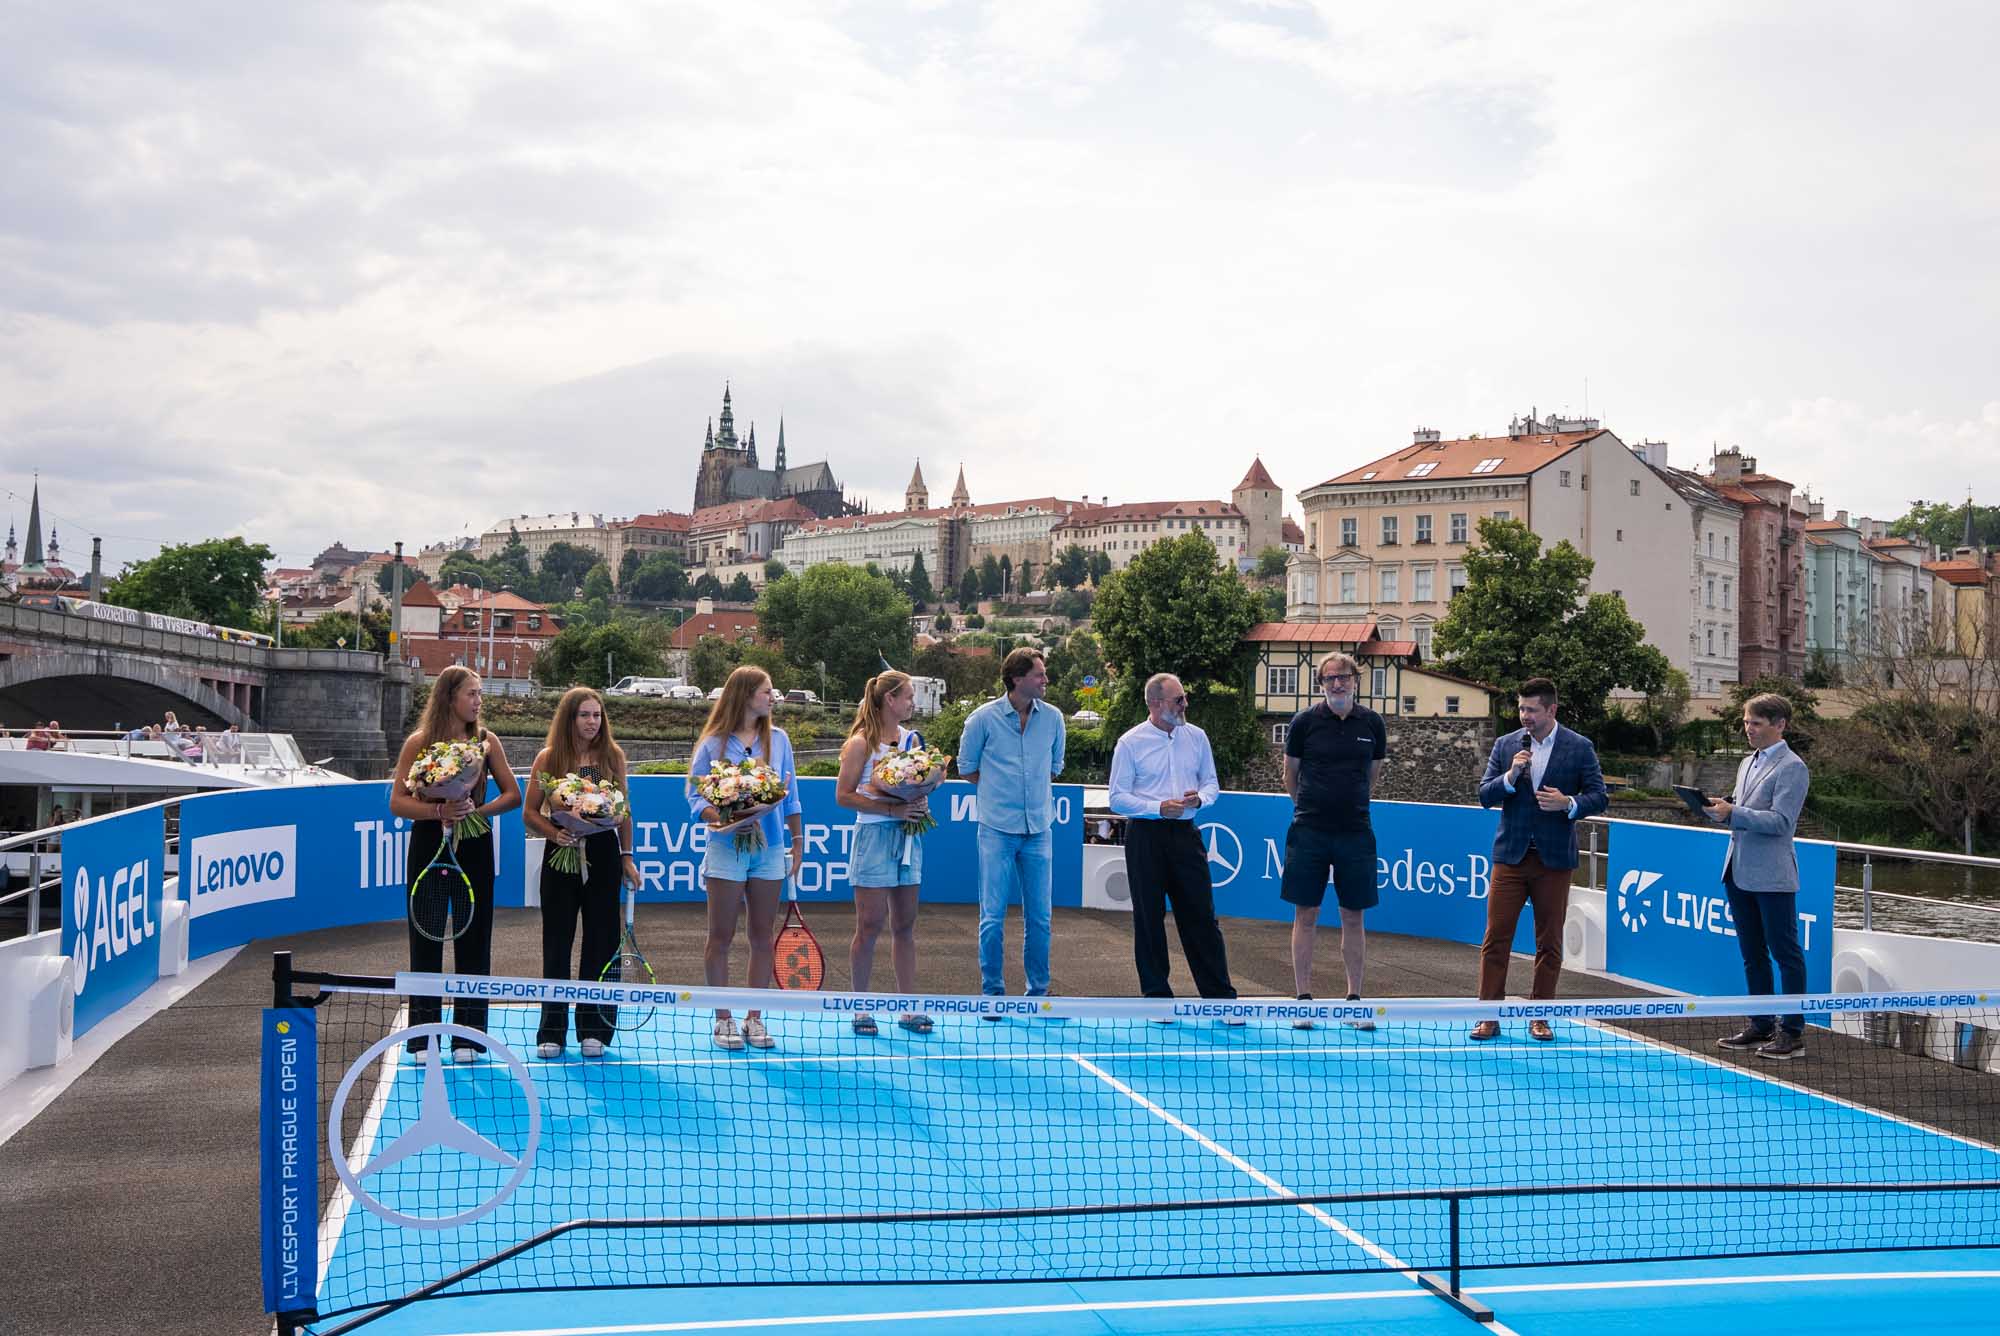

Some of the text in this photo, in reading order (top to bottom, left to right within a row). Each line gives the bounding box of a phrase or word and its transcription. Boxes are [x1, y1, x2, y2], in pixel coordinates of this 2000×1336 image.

[197, 849, 285, 896] Lenovo
[90, 859, 154, 971] AGEL
[1663, 890, 1817, 951] LIVEST
[445, 980, 676, 1004] LIVESPORT PRAGUE OPEN
[1801, 994, 1976, 1011] LIVESPORT PRAGUE OPEN
[823, 998, 1038, 1014] LIVESPORT PRAGUE OPEN
[1174, 1004, 1373, 1019] LIVESPORT PRAGUE OPEN
[1498, 1003, 1684, 1017] LIVESPORT PRAGUE OPEN
[281, 1038, 298, 1299] LIVESPORT PRAGUE OPEN
